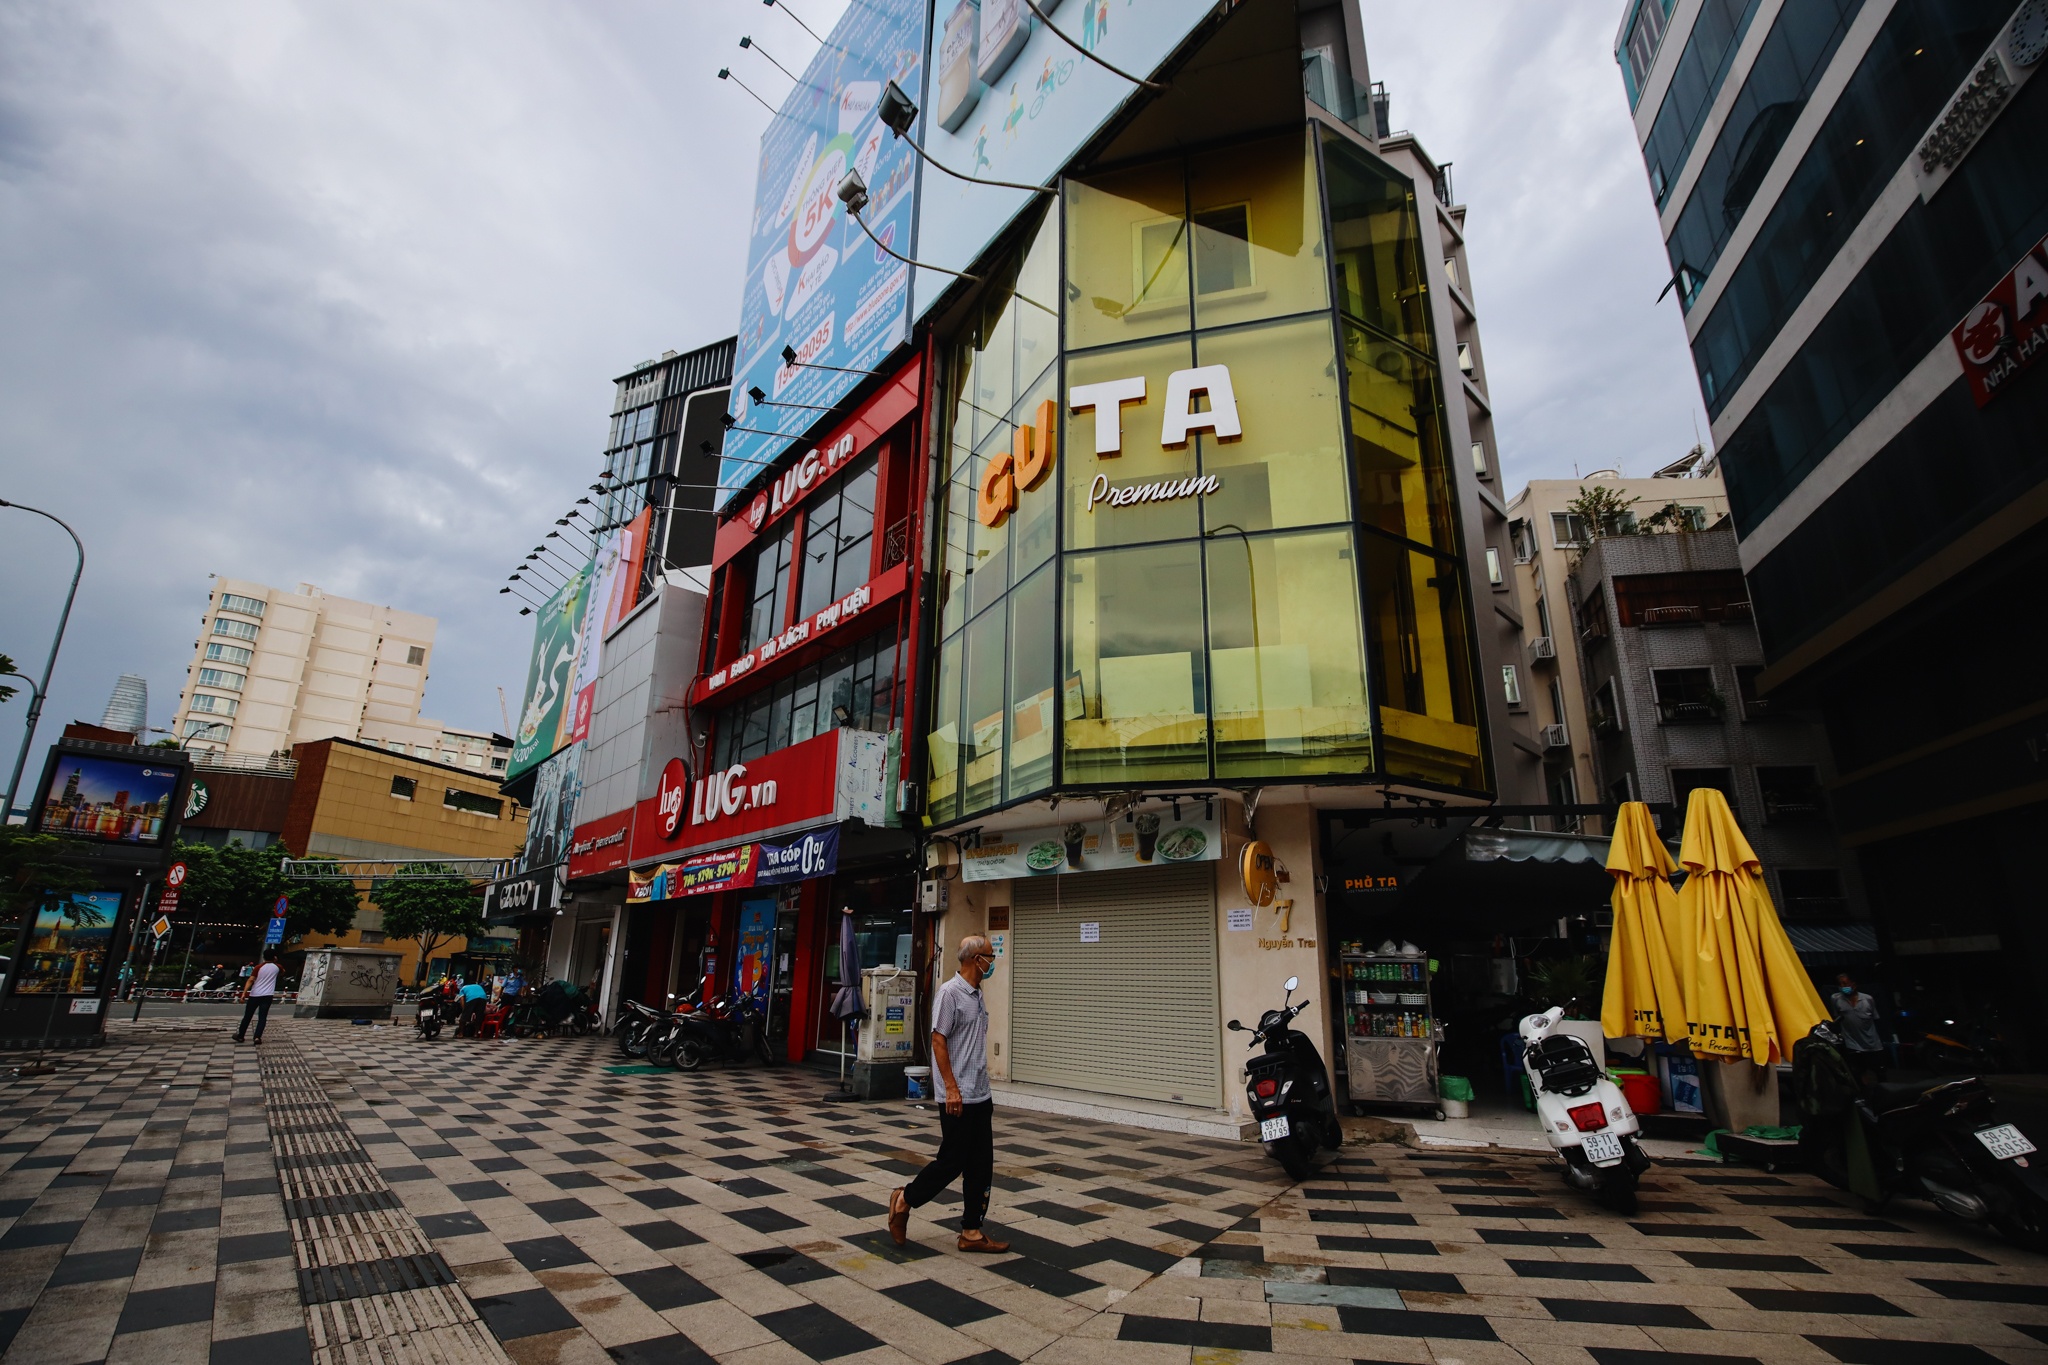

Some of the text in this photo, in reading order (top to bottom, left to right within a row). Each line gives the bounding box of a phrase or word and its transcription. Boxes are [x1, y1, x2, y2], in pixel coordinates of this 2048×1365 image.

[1918, 58, 1996, 160] WORKSPACE
[1924, 78, 2000, 174] COMMUNITY
[1943, 85, 2010, 169] SERVICES
[804, 177, 836, 238] 5K
[873, 300, 896, 332] COVID-19
[848, 344, 878, 384] COVID-19
[1983, 352, 2018, 392] NHÀ
[1070, 364, 1242, 454] TA
[770, 434, 854, 516] LUG.vn
[1088, 473, 1220, 512] Premium
[750, 499, 766, 528] lug
[816, 602, 841, 630] PHỤ
[842, 586, 870, 616] KIỆN
[658, 773, 682, 832] lug
[692, 764, 777, 826] LUG.vn
[781, 845, 801, 863] GÓP
[802, 836, 825, 874] 0%
[1345, 875, 1397, 889] PHỞ TA
[1274, 899, 1293, 932] 7
[1258, 935, 1293, 950] Nguyễn
[1264, 1118, 1284, 1130] 59-F2
[1264, 1127, 1288, 1142] 187.95
[1586, 1134, 1613, 1148] 59-T1
[1982, 1128, 2016, 1144] 59-S2
[1588, 1144, 1622, 1161] 621.45
[1990, 1138, 2032, 1158] 669.55
